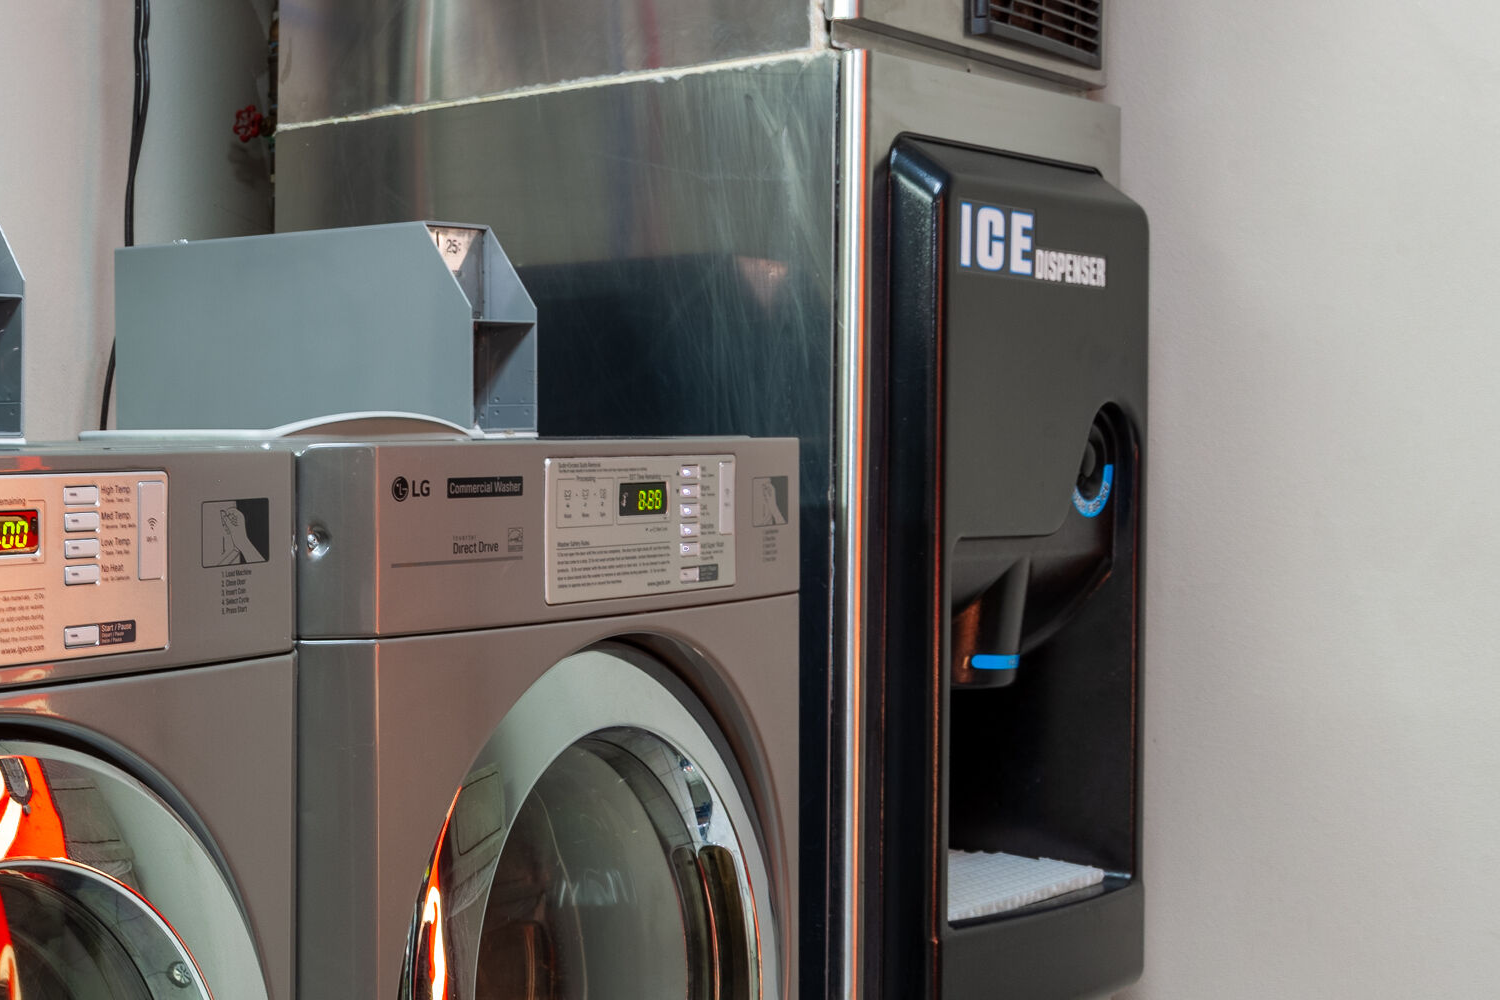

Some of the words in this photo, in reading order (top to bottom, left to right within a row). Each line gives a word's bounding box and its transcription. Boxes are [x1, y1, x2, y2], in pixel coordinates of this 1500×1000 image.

[960, 202, 1034, 275] ICE
[1035, 249, 1106, 287] DISPENSER
[101, 485, 114, 496] High
[412, 480, 430, 497] LG
[449, 482, 493, 494] Commercial
[494, 481, 522, 493] Washer
[101, 537, 113, 547] Low
[453, 542, 477, 555] Direct
[478, 541, 499, 553] Drive
[101, 565, 109, 573] No
[110, 564, 124, 572] Heat
[101, 624, 114, 632] Start
[117, 623, 132, 631] Pause
